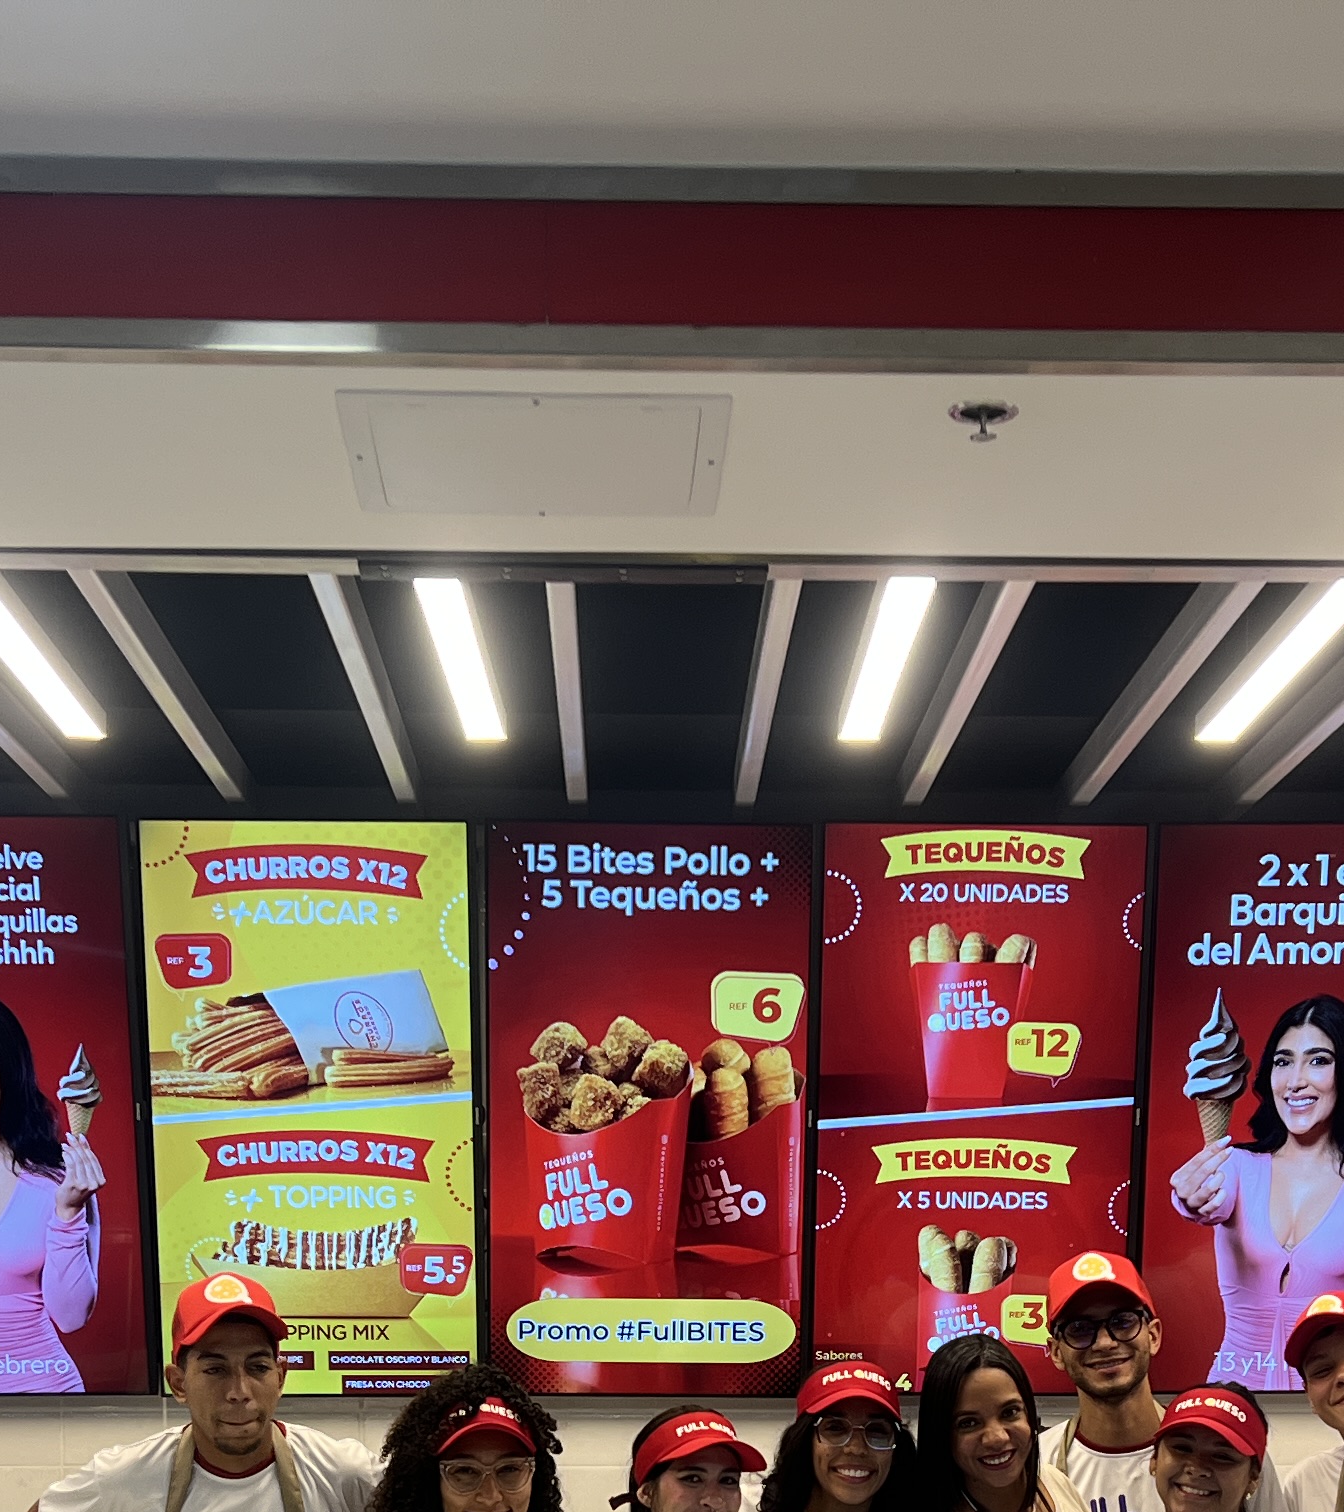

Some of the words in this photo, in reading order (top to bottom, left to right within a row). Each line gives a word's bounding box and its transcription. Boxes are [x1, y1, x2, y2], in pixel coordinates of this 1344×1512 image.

[522, 844, 556, 873] 15
[567, 842, 655, 875] Bites
[664, 845, 751, 876] Pollo
[760, 851, 779, 872] +
[906, 836, 1065, 868] TEQUEÑOS
[205, 855, 350, 885] CHURROS
[356, 858, 408, 889] X12
[1257, 854, 1281, 887] 2
[1288, 863, 1309, 887] x
[1315, 854, 1330, 887] 1
[541, 879, 562, 909] 5
[569, 879, 741, 917] Tequeños
[750, 887, 769, 907] +
[899, 883, 915, 902] X
[920, 883, 948, 902] 20
[954, 883, 1069, 904] UNIDADES
[1187, 932, 1242, 966] del
[187, 946, 213, 978] 3
[938, 979, 988, 991] TEQUEÑOS
[729, 1002, 748, 1011] REF
[752, 987, 782, 1024] 6
[939, 989, 995, 1012] FULL
[927, 1007, 1010, 1032] QUESO
[1015, 1038, 1032, 1046] REF
[1031, 1029, 1069, 1058] 12
[217, 1139, 359, 1167] CHURROS
[364, 1141, 416, 1171] X12
[543, 1149, 594, 1171] TEQUEÑOS
[896, 1144, 1052, 1174] TEQUEÑOS
[545, 1162, 608, 1200] FULL
[268, 1185, 397, 1209] TOPPING
[539, 1188, 633, 1230] QUESO
[897, 1191, 912, 1209] X
[917, 1191, 930, 1209] 5
[936, 1191, 1048, 1210] UNIDADES
[354, 1325, 390, 1340] MIX
[517, 1319, 609, 1342] Promo
[616, 1319, 765, 1343] #FullBITES
[935, 1312, 986, 1335] FULL
[330, 1355, 384, 1364] CHOCOLATE
[385, 1355, 423, 1364] OSCURO
[424, 1355, 430, 1364] Y
[431, 1355, 468, 1364] BLANCO
[815, 1350, 863, 1361] Sabores
[345, 1380, 374, 1389] FRESA
[374, 1380, 395, 1389] CON
[822, 1370, 852, 1386] FULL
[895, 1373, 913, 1391] 4
[1175, 1397, 1203, 1413] FULL
[1205, 1397, 1247, 1423] QUESO
[676, 1421, 709, 1437] FULL
